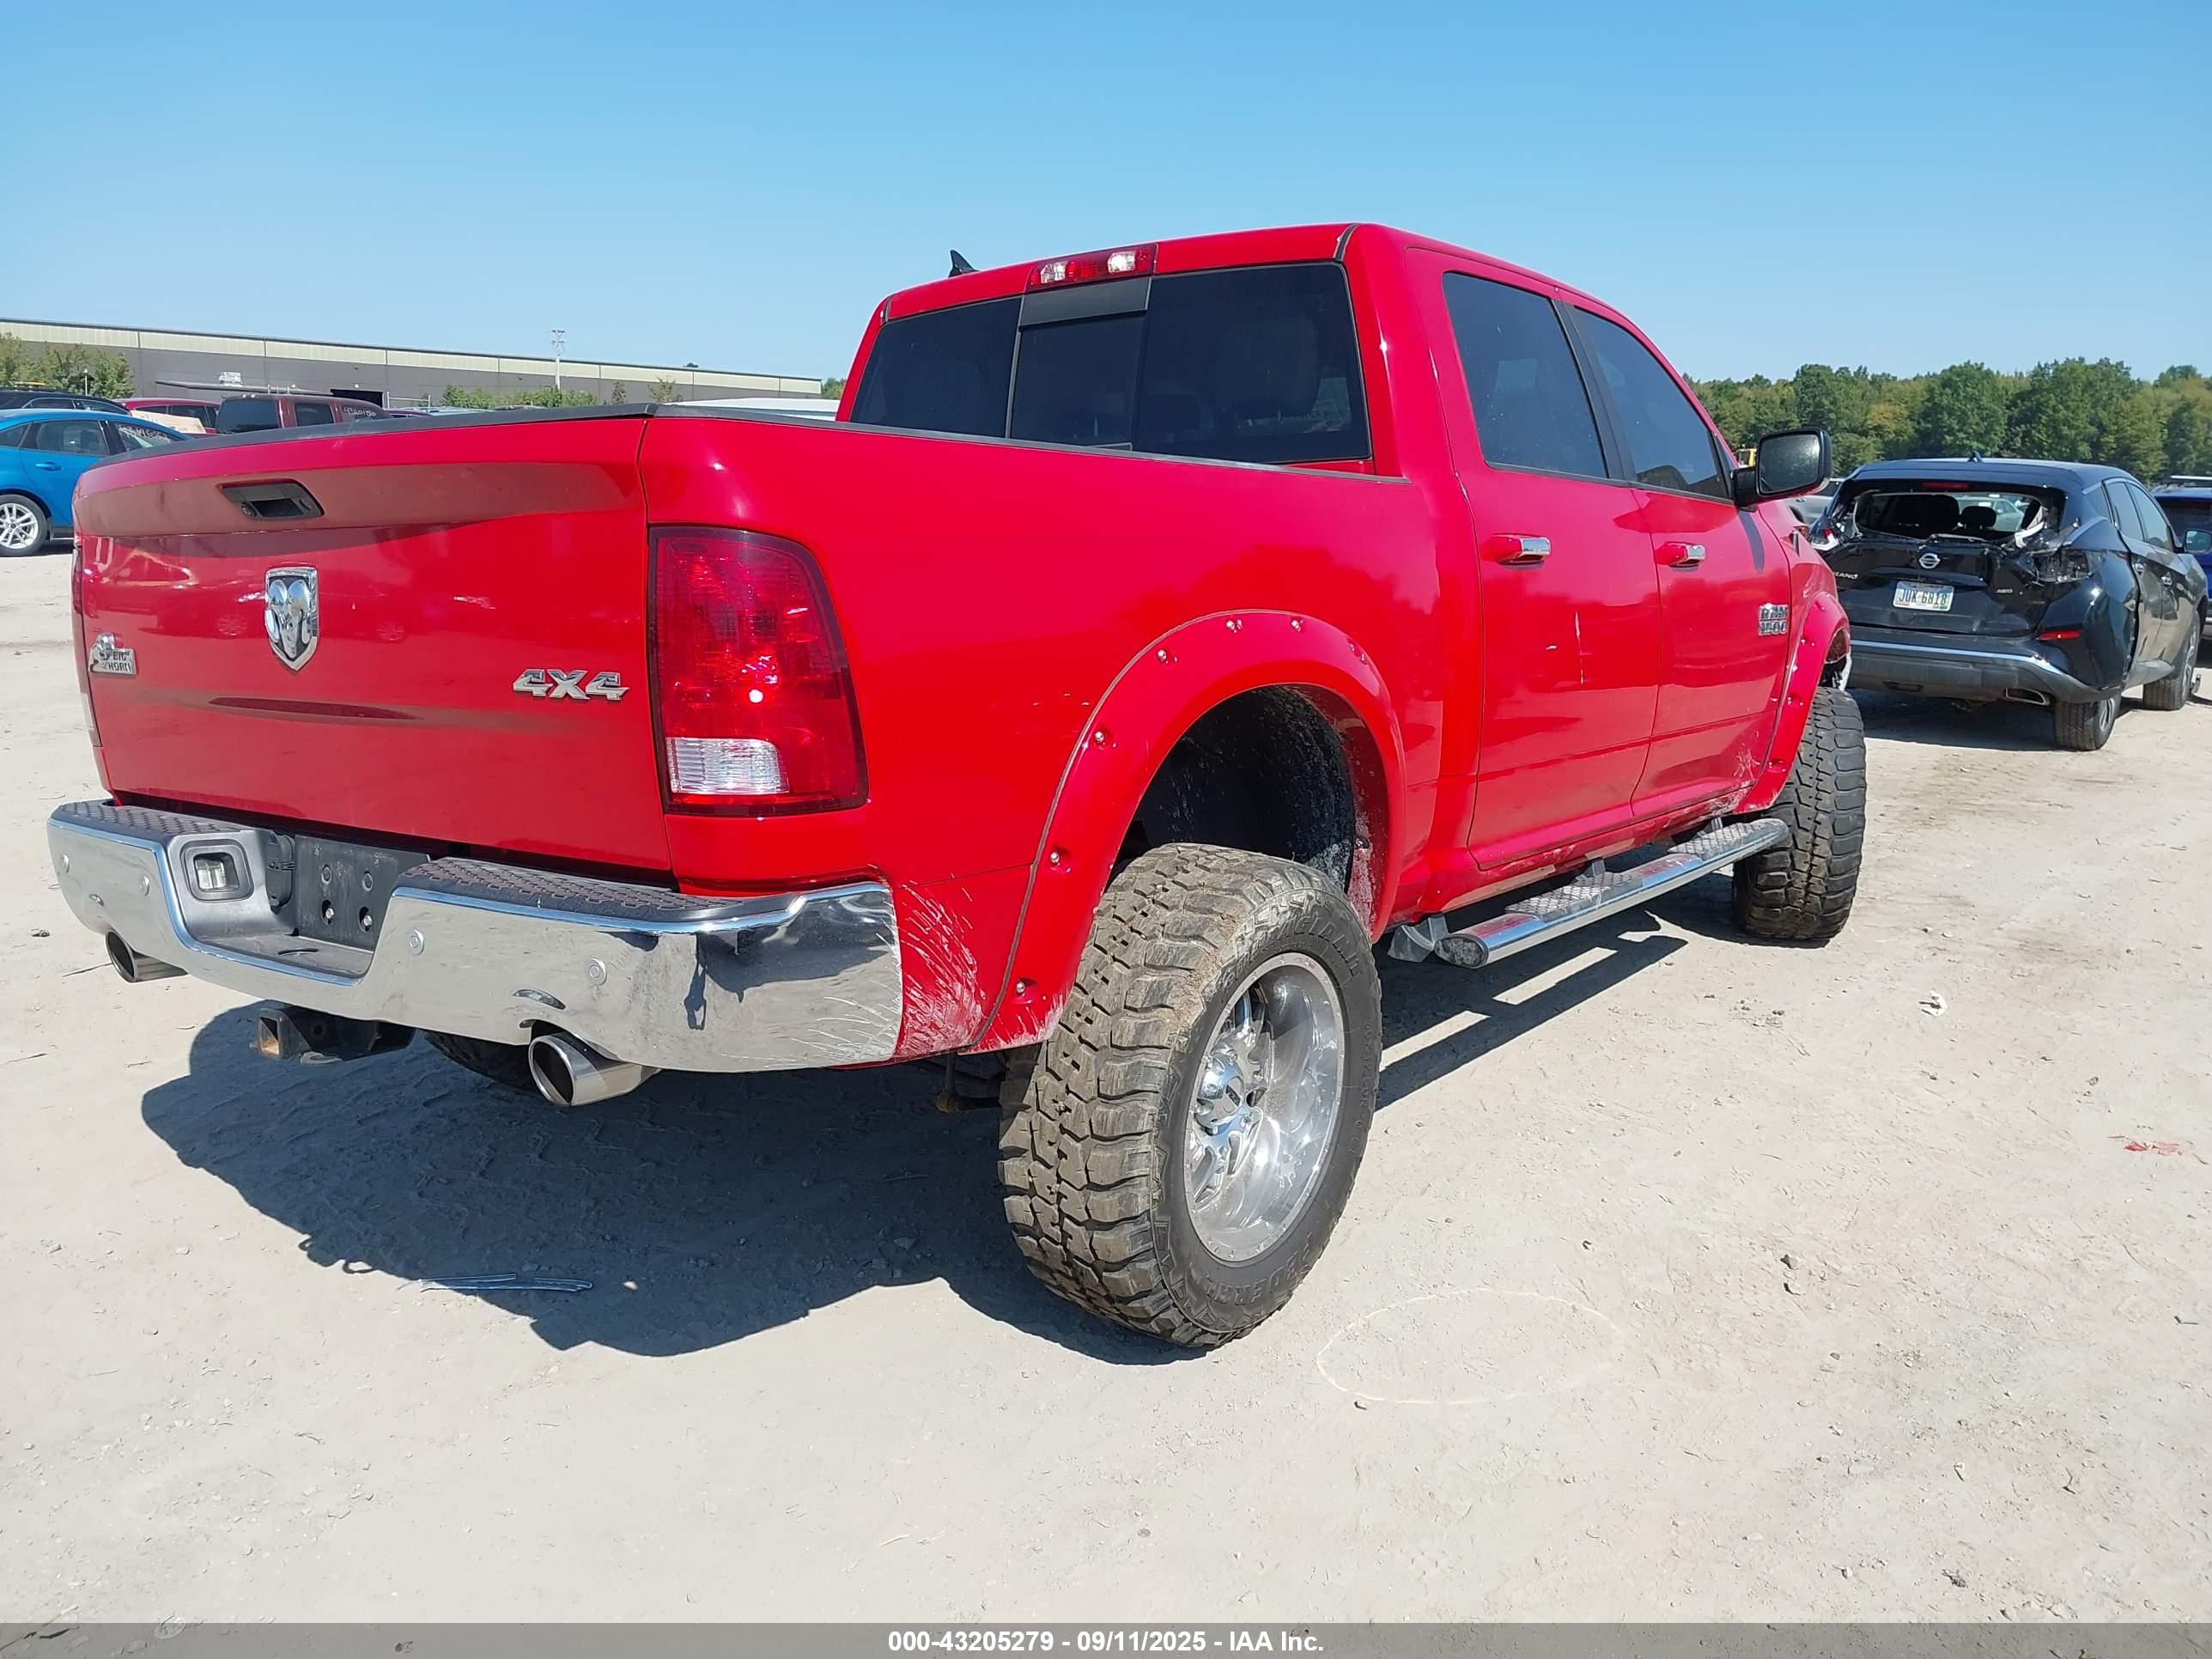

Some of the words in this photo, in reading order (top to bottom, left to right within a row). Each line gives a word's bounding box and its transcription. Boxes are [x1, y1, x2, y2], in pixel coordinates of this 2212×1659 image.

[112, 651, 131, 661] BIG
[108, 662, 131, 672] HORN
[513, 668, 630, 701] 4X4
